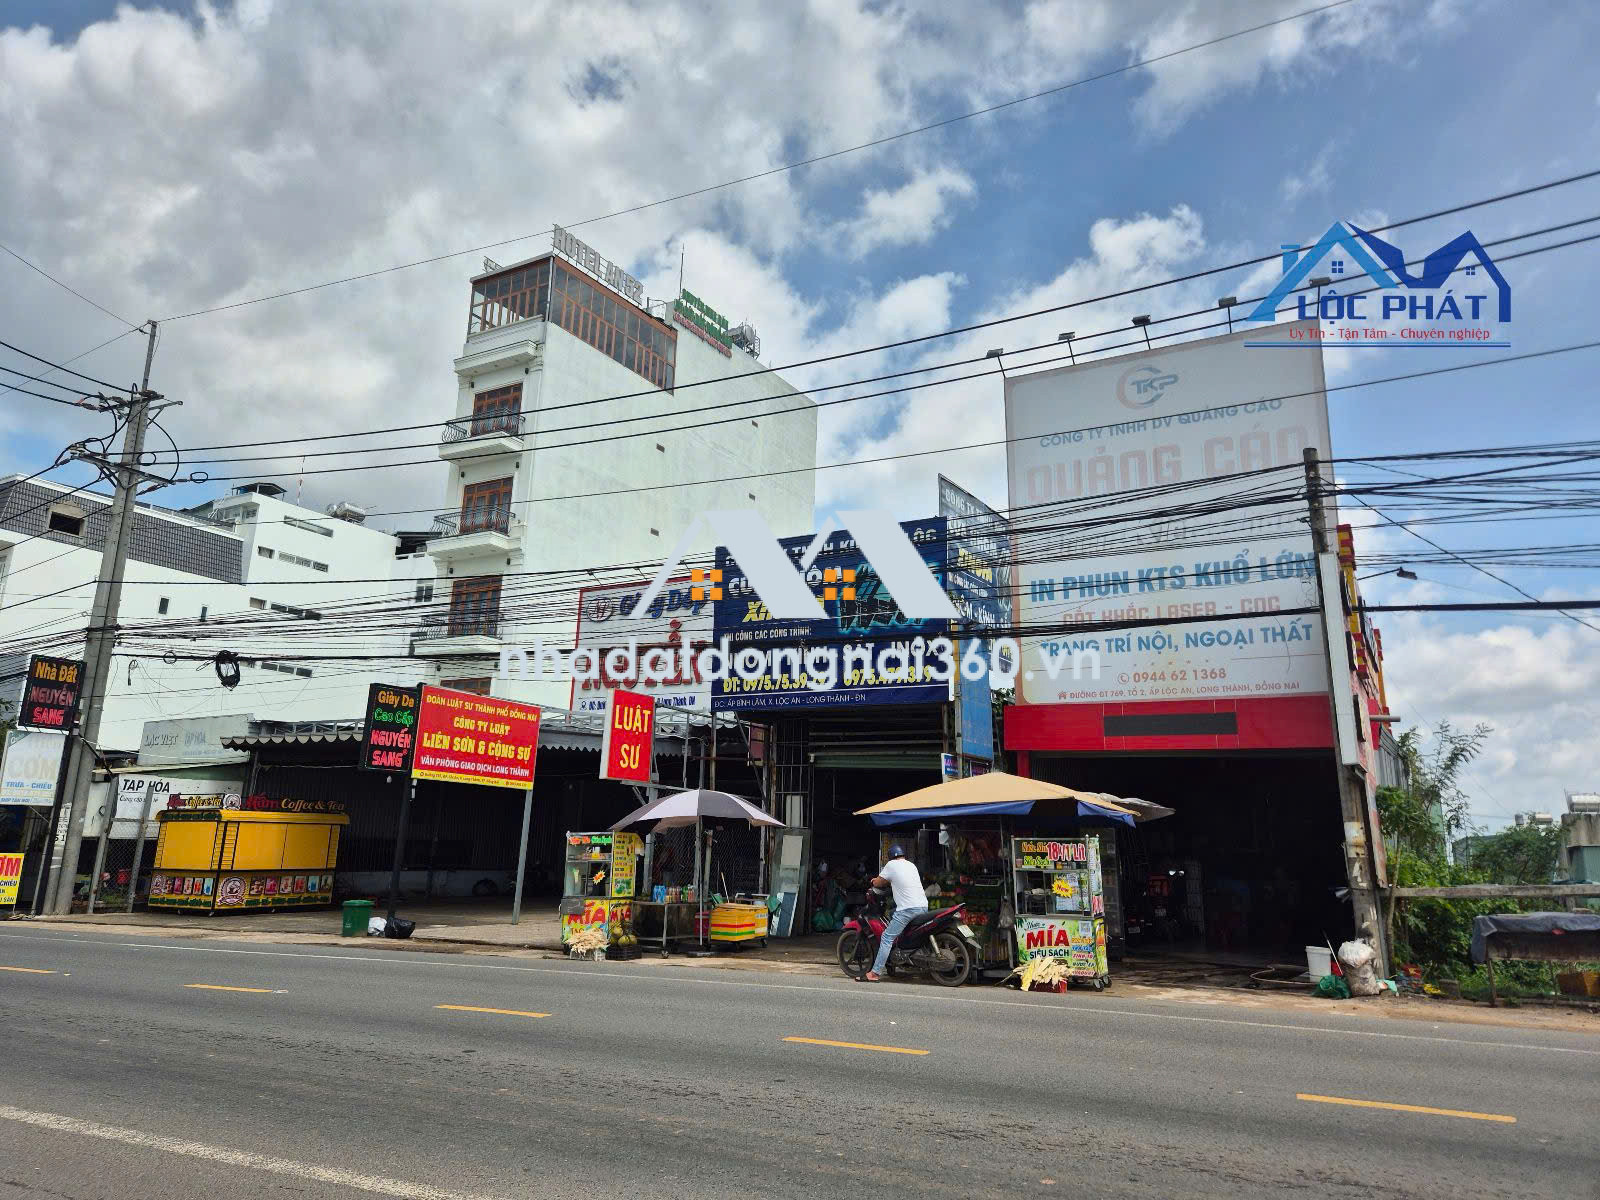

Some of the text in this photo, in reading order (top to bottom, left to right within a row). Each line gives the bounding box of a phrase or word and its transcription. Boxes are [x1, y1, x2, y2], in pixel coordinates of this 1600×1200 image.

[553, 224, 602, 275] HOTEL
[1088, 427, 1103, 440] TY
[1109, 421, 1147, 437] TNHH
[1031, 578, 1055, 602] IN
[1062, 571, 1131, 599] PHUN
[1138, 563, 1186, 592] KTS
[1194, 549, 1251, 586] KHỔ
[1105, 630, 1132, 653] TRÍ
[1137, 629, 1179, 655] NỘI,
[1185, 627, 1255, 650] NGOẠI
[1260, 618, 1312, 644] THẤT
[35, 660, 78, 683] Nhà Đất
[1133, 667, 1227, 684] 0944 62 1368
[378, 690, 414, 707] Giày Da
[1196, 685, 1219, 694] LONG
[1284, 681, 1300, 690] NAI
[32, 706, 64, 726] SANG
[373, 709, 394, 722] Cao
[426, 694, 446, 706] ĐOÀN
[447, 698, 463, 711] LUẬT
[464, 701, 473, 711] SƯ
[475, 701, 496, 715] THÀNH
[496, 705, 509, 718] PHỐ
[509, 708, 526, 721] ĐỒNG
[453, 715, 511, 737] CÔNG TY LUẬT
[614, 704, 651, 734] LUẬT
[372, 750, 405, 767] SANG
[422, 731, 533, 766] LIÊN SƠN & CỘNG SỰ
[619, 743, 641, 769] SƯ
[421, 755, 530, 777] VĂN PHÒNG GIAO DỊCH LONG THÀNH
[281, 798, 313, 812] Coffee
[314, 799, 324, 810] &
[326, 800, 345, 811] Tea
[1026, 924, 1070, 950] MÍA
